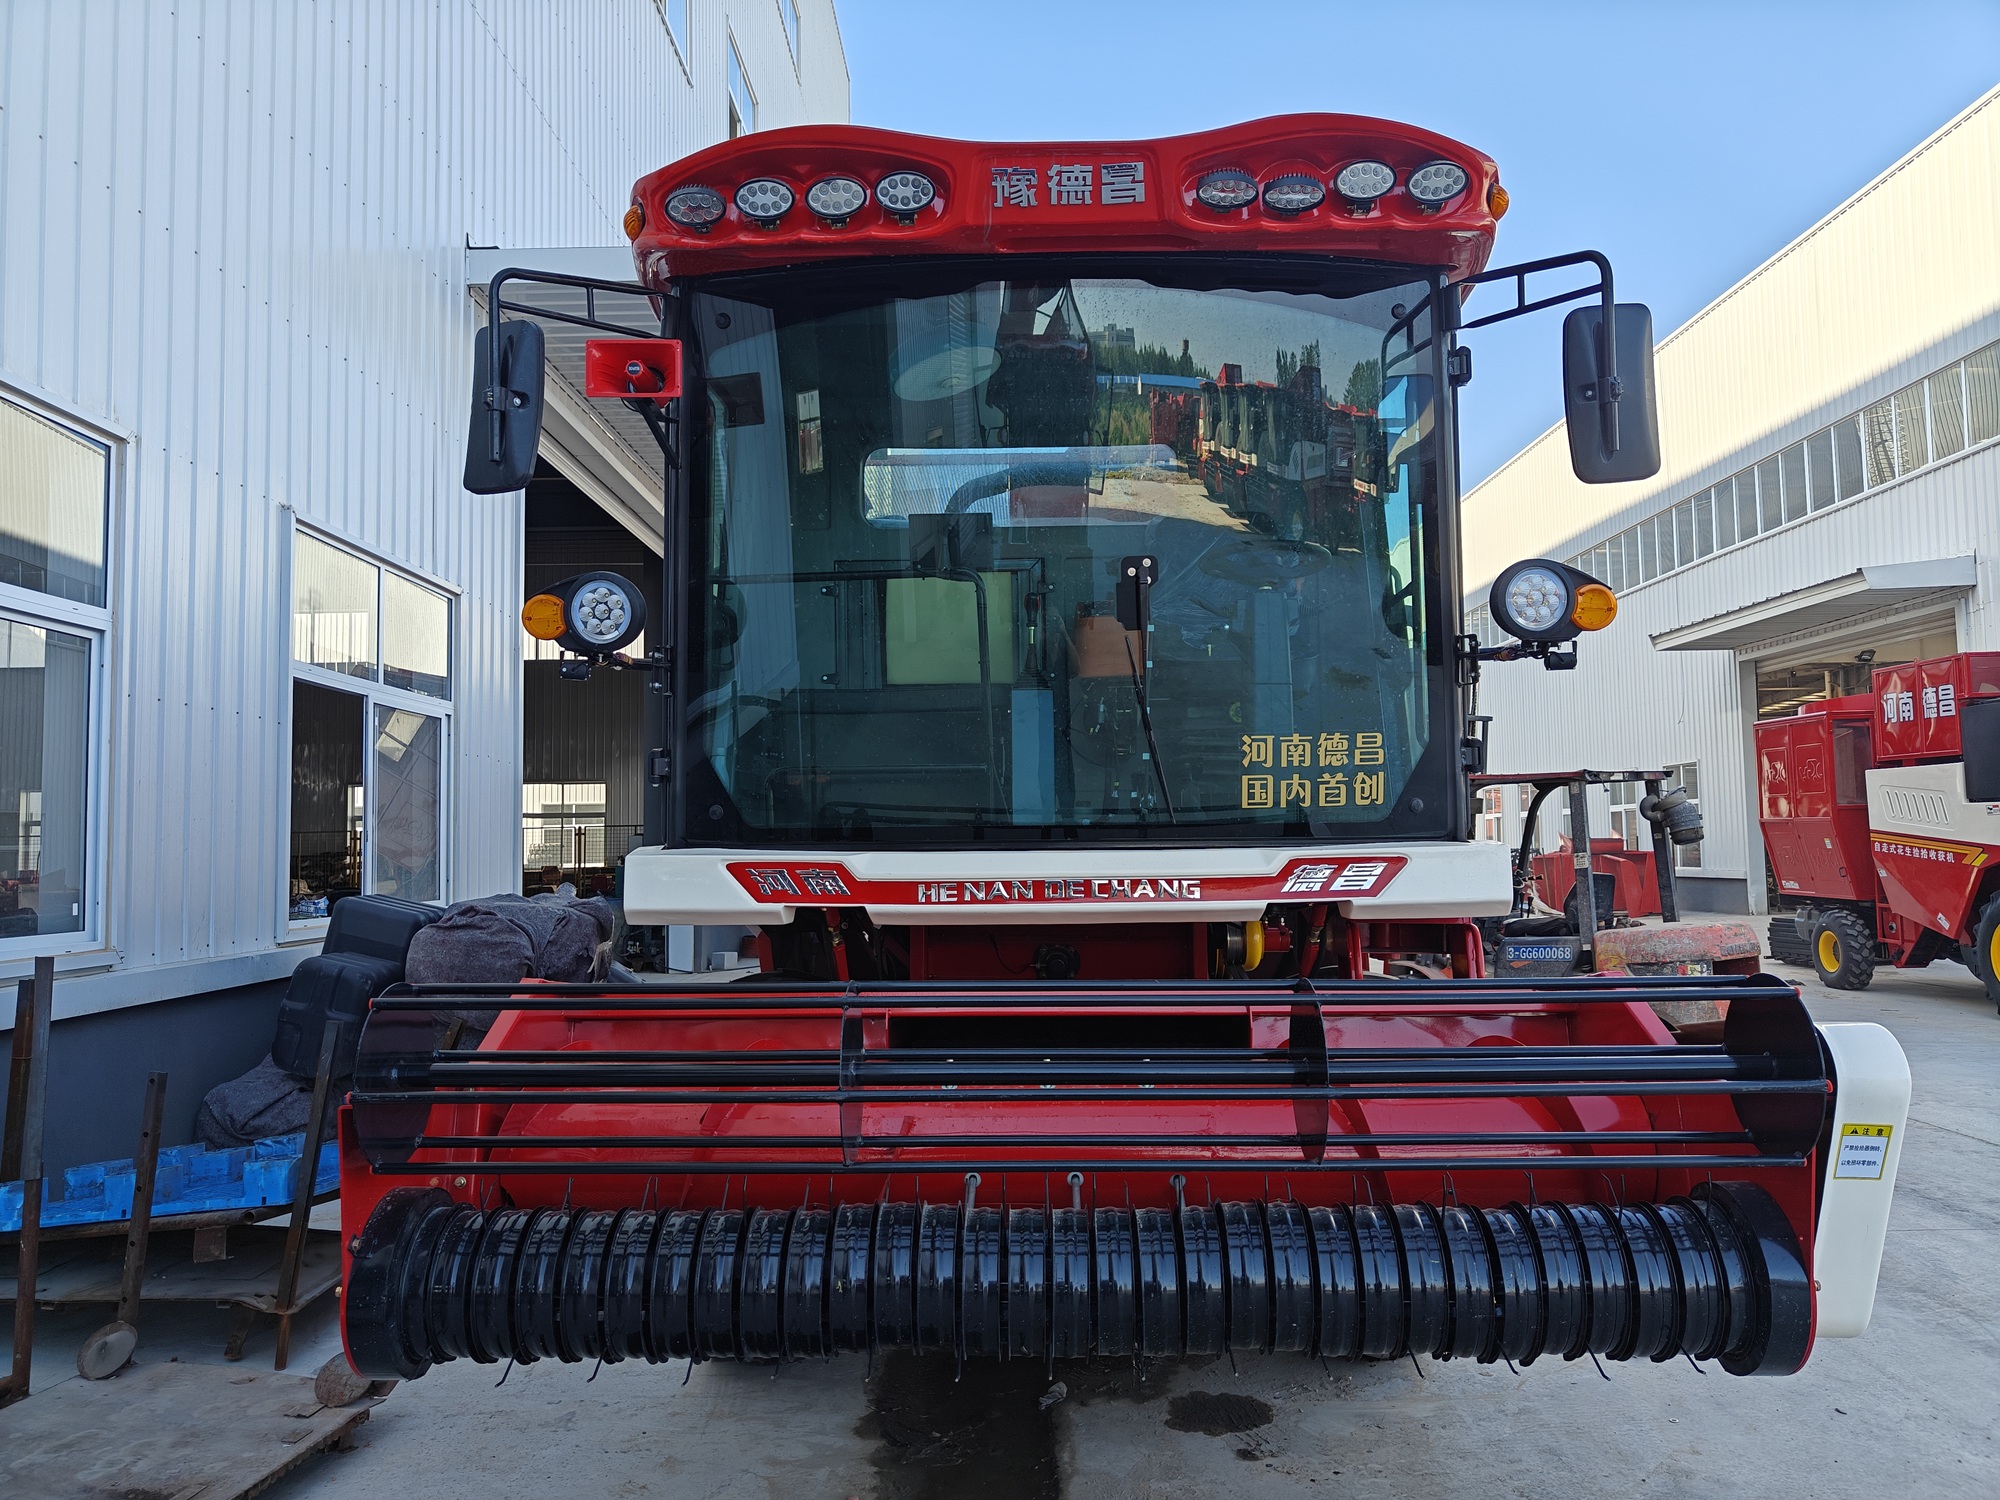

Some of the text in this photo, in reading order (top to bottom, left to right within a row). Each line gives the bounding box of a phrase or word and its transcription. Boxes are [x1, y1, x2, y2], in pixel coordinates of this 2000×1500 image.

[991, 162, 1145, 208] 豫德昌
[1881, 684, 1956, 724] 河南 德昌
[1241, 732, 1385, 768] 河南德昌
[1241, 771, 1385, 809] 国内首创
[745, 868, 851, 896] 河南
[1092, 879, 1200, 899] CHANG
[1280, 862, 1389, 893] 德昌
[1507, 947, 1571, 959] 3-GG600068
[1862, 1127, 1884, 1136] 注意
